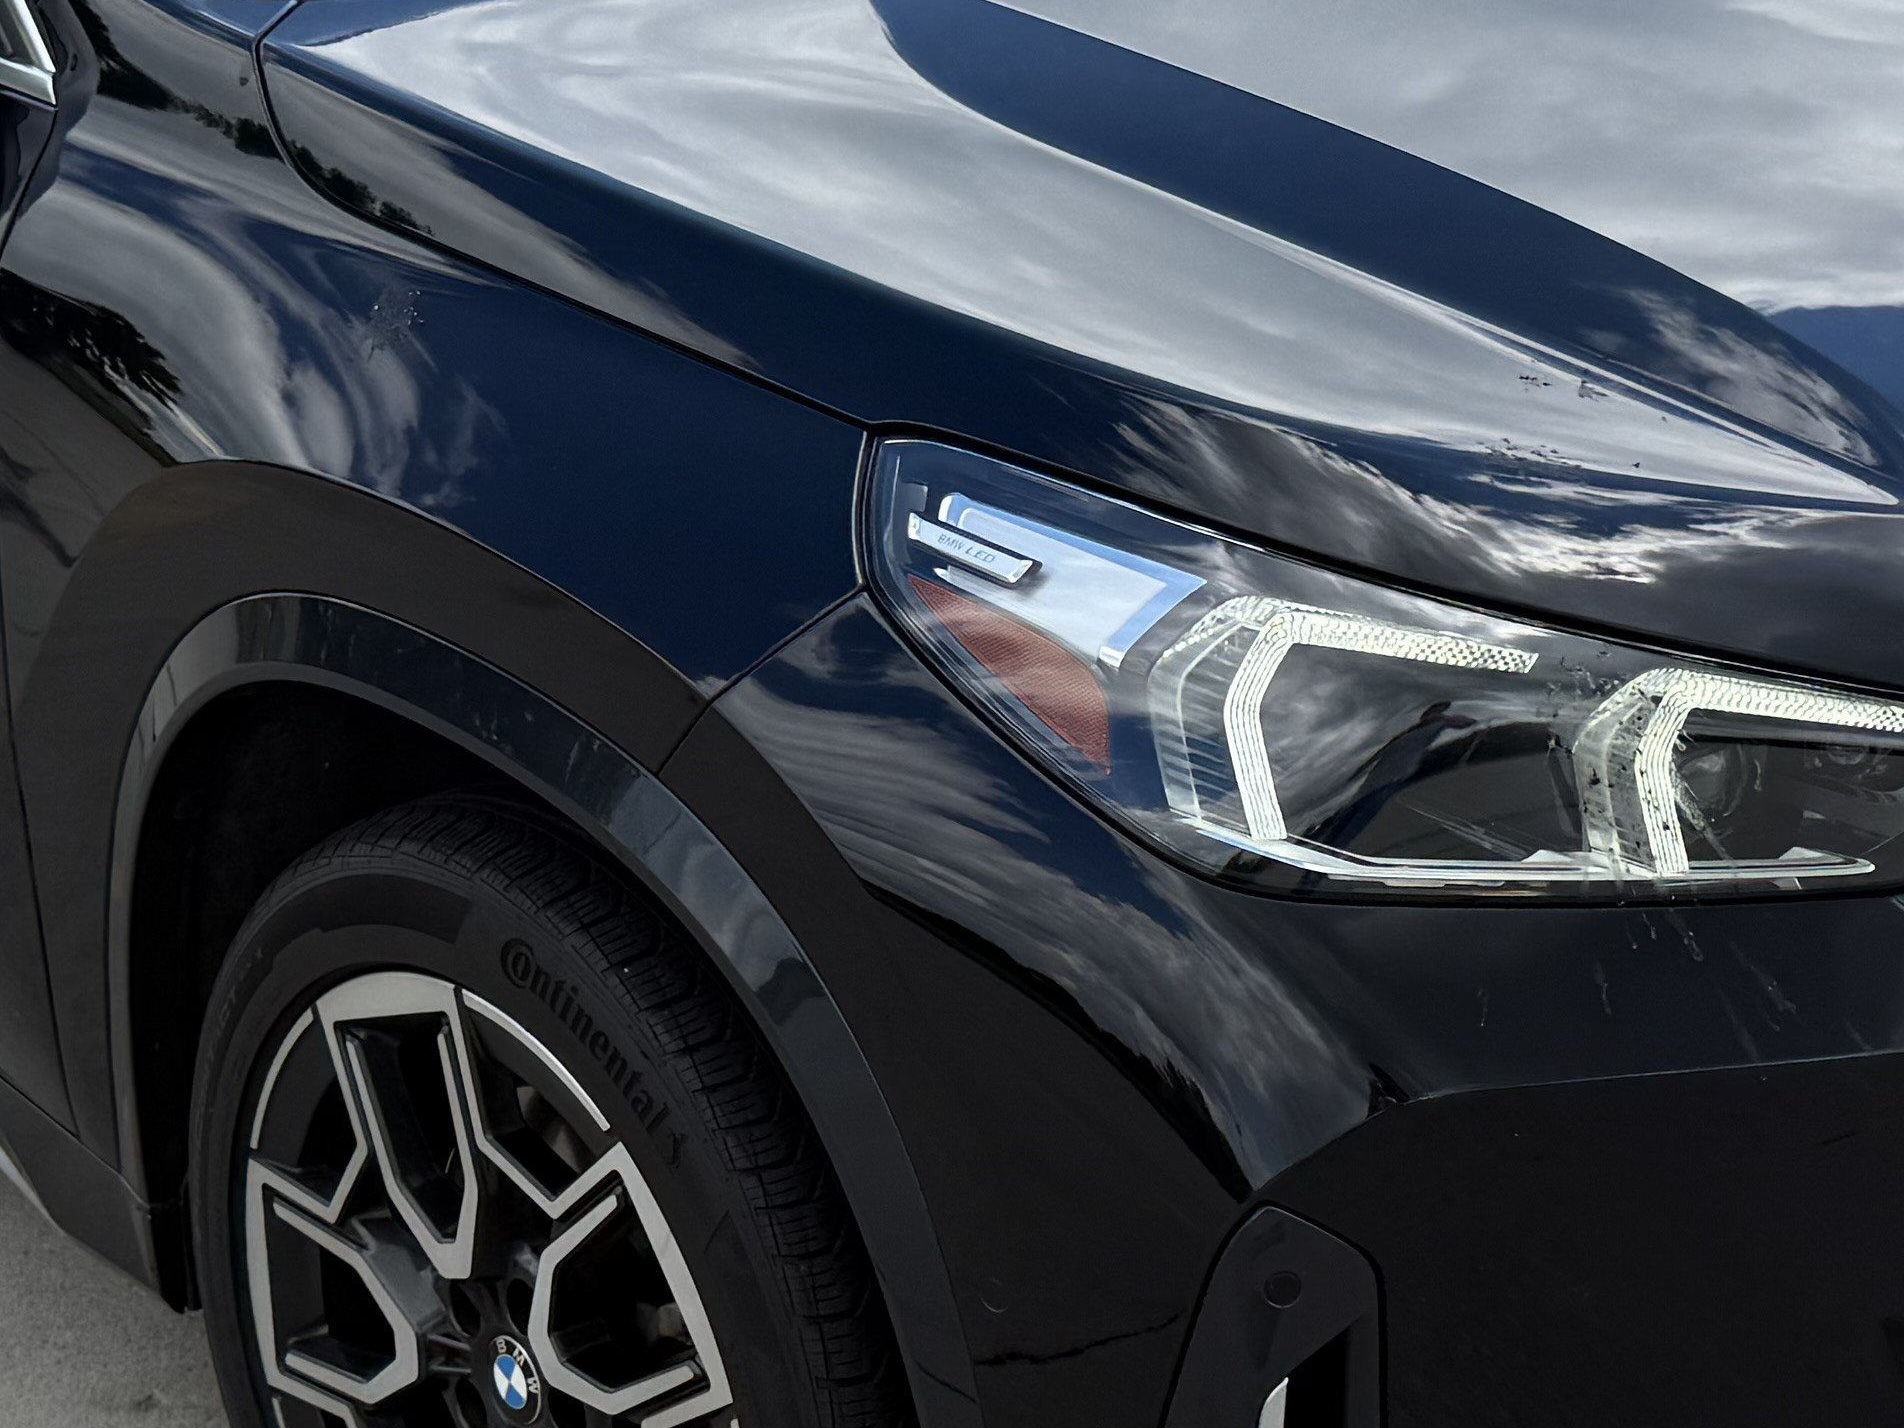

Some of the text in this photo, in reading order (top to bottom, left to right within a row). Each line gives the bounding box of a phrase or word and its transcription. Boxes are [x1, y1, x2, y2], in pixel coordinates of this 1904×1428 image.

[937, 533, 997, 563] BMW LED
[499, 937, 672, 1133] Continental
[496, 1337, 540, 1394] BMW
